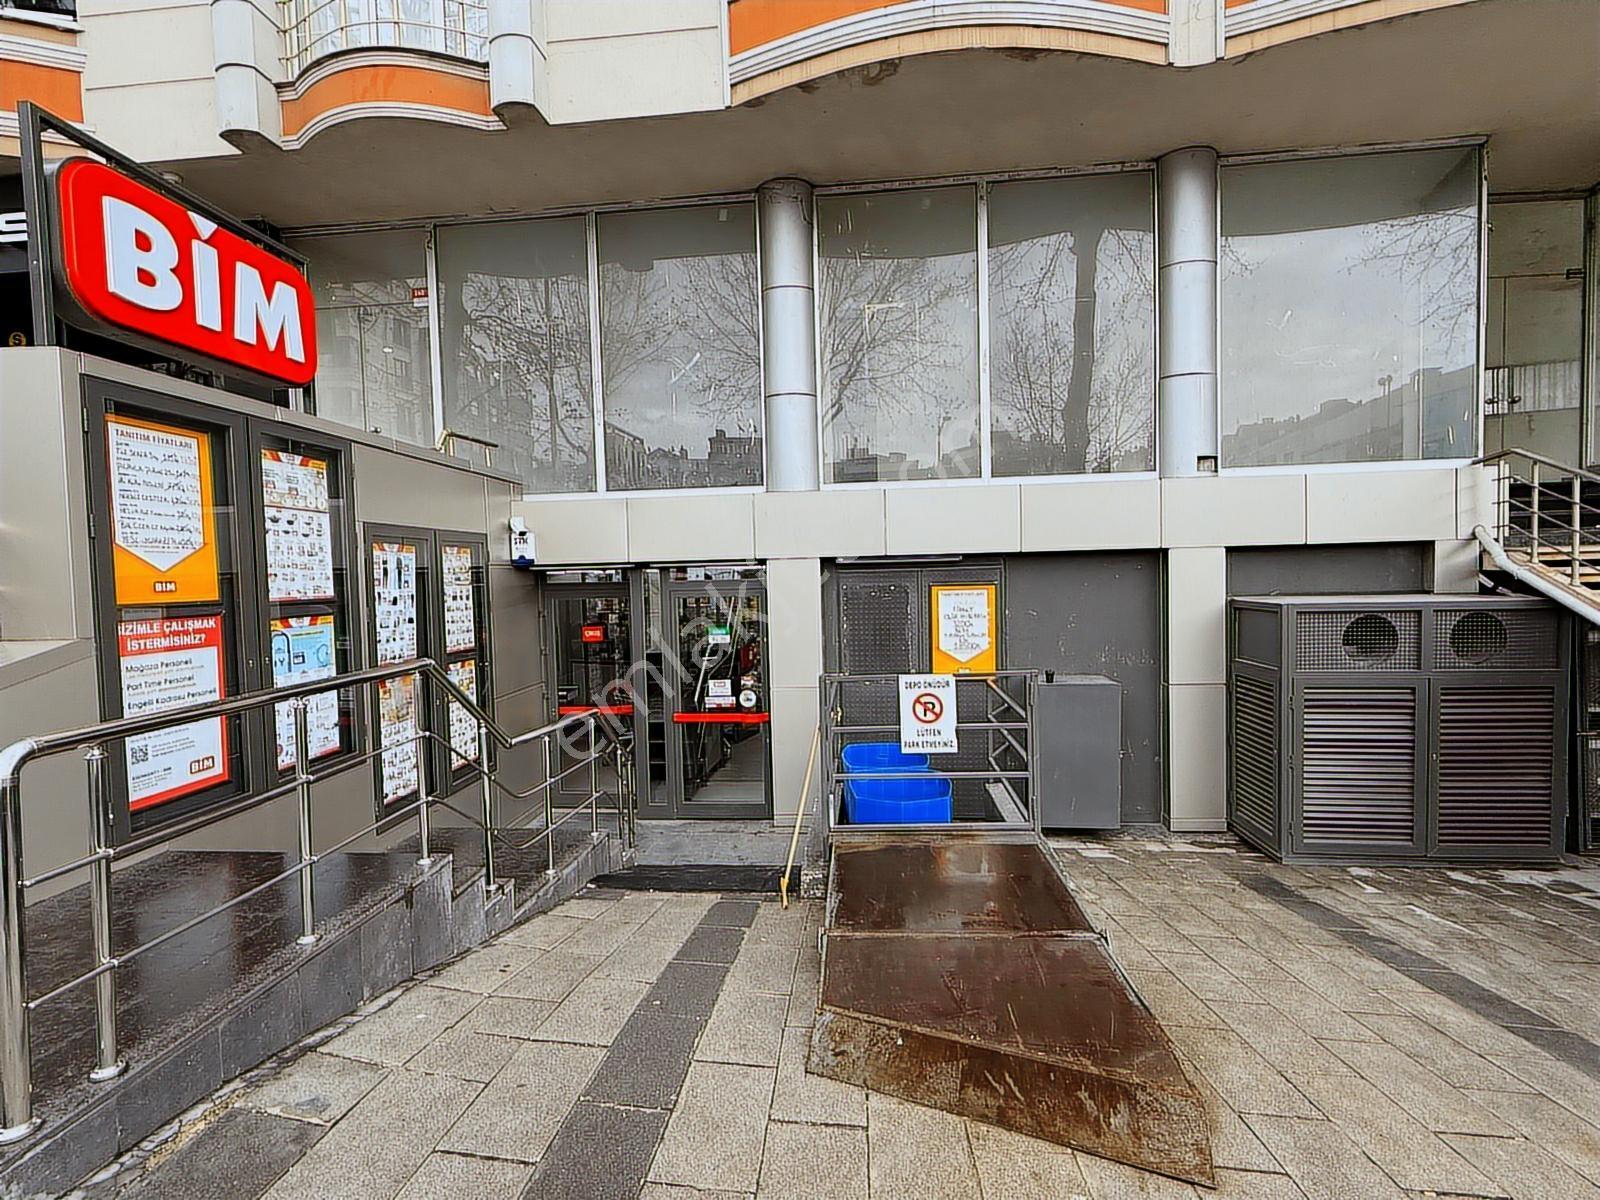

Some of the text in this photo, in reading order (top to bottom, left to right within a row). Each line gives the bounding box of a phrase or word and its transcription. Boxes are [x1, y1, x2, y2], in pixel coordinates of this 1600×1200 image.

[102, 195, 305, 364] BİM
[163, 618, 216, 635] ÇALIŞMAK
[127, 632, 206, 651] İSTERMİSİNİZ?
[127, 681, 142, 691] Part
[144, 680, 161, 688] Time
[916, 727, 942, 737] LÜTFEN
